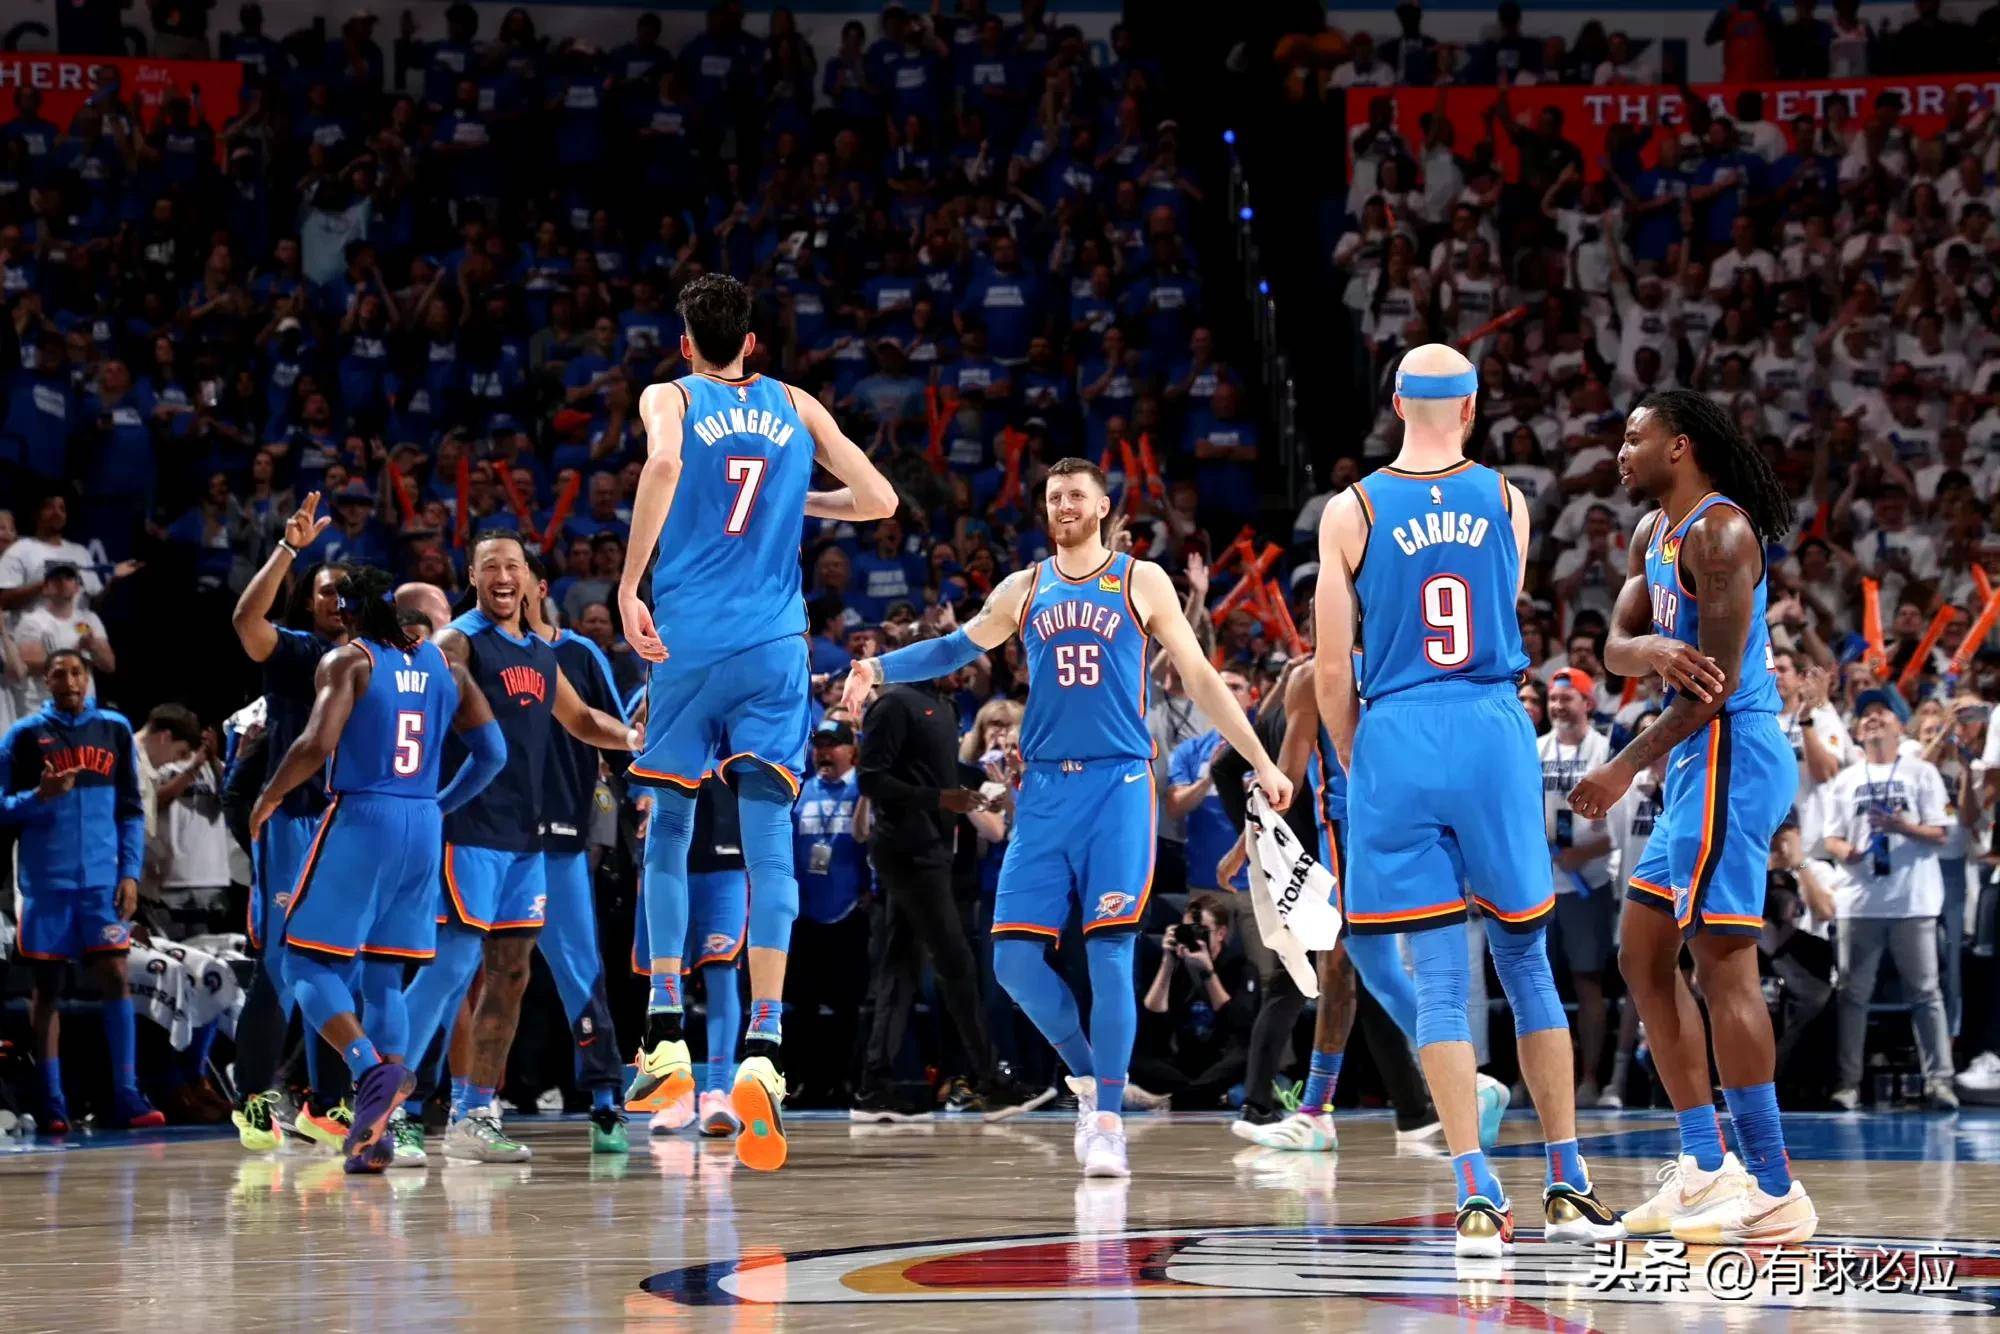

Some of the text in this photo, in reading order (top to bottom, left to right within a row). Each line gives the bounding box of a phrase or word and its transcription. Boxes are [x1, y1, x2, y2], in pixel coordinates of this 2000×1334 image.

[1583, 94, 1684, 126] THE
[1707, 87, 1868, 121] AETT
[693, 407, 794, 447] HOLMGREN
[724, 455, 768, 535] 7
[1392, 511, 1489, 556] CARUSO
[1032, 601, 1122, 640] THUNDER
[1420, 572, 1474, 670] 9
[1055, 644, 1100, 687] 55
[43, 745, 115, 776] HUNDER
[393, 710, 425, 779] 5
